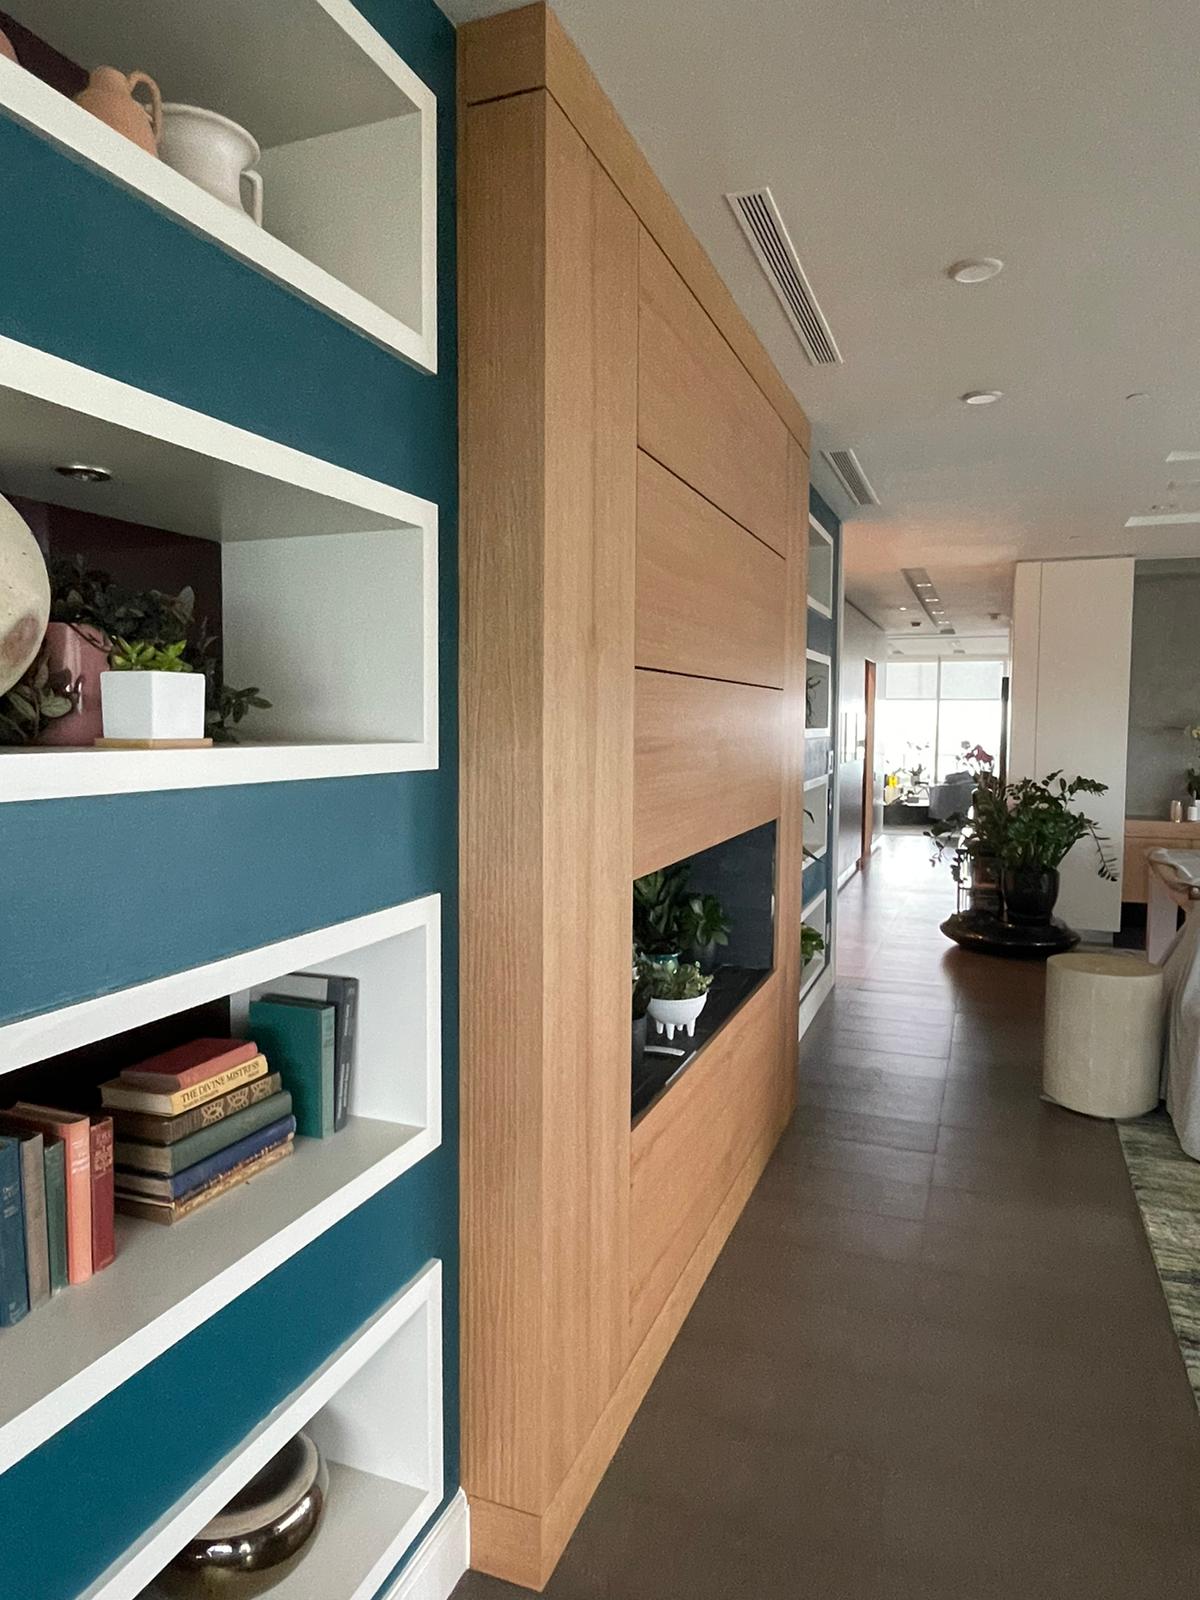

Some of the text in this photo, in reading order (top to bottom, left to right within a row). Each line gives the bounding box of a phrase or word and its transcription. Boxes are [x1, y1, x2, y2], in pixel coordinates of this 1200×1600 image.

[181, 1089, 199, 1103] THE
[199, 1077, 225, 1095] DIVINE
[226, 1061, 259, 1080] MISTRESS
